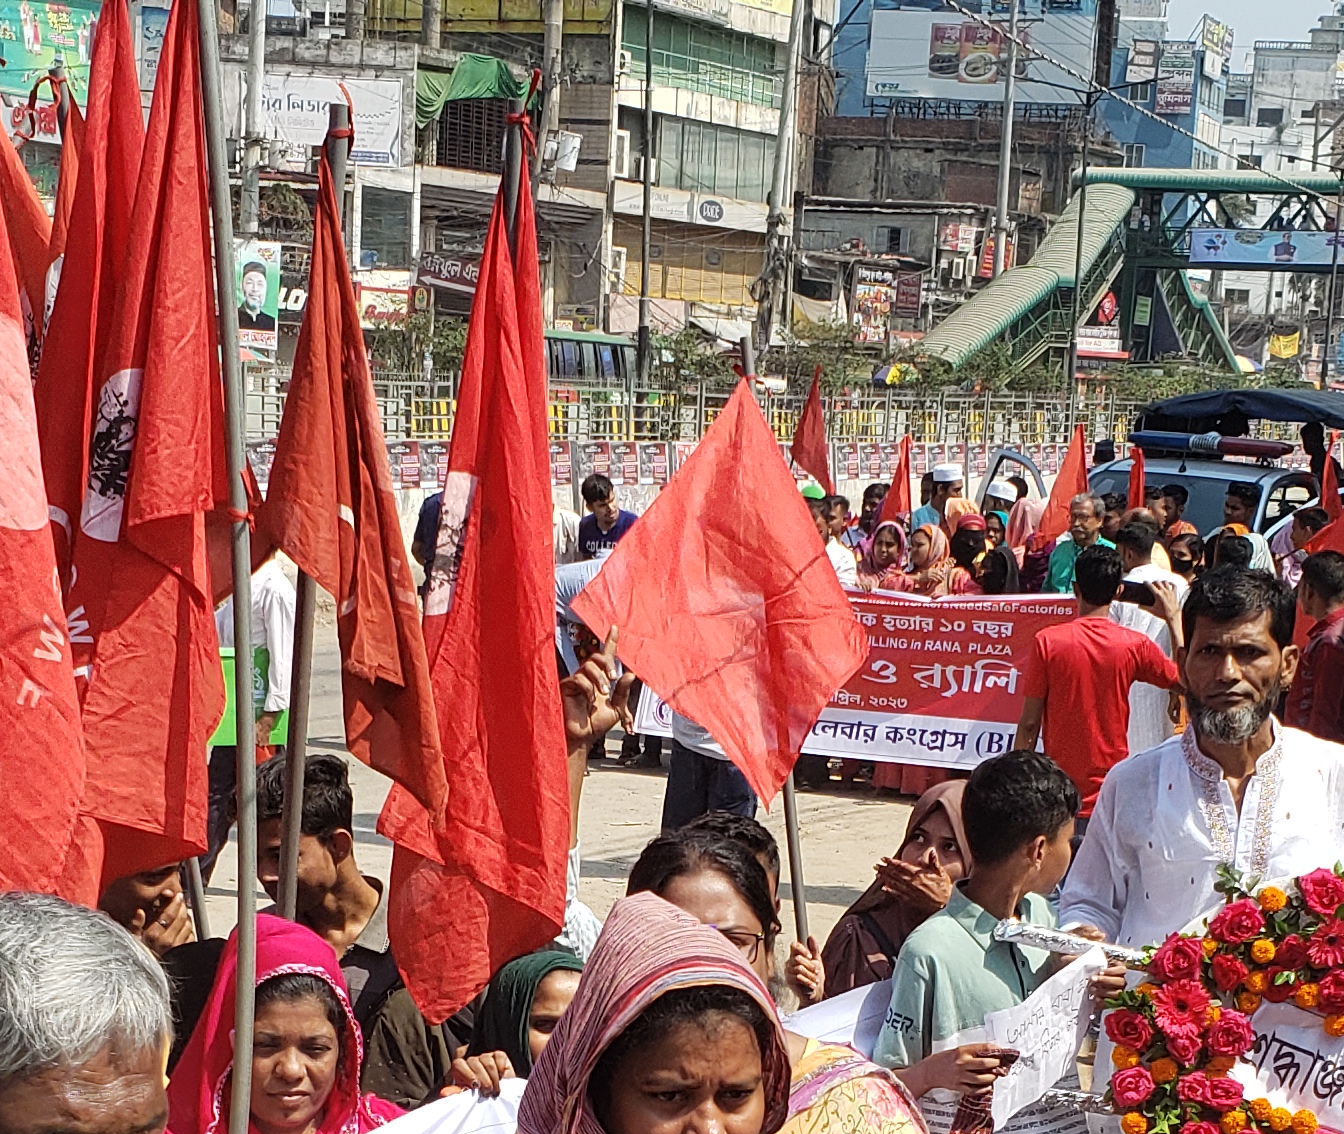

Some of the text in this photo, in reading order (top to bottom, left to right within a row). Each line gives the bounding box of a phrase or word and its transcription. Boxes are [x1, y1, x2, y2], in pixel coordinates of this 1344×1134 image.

[882, 615, 934, 632] হত্যার
[939, 619, 966, 632] ১০
[972, 619, 1014, 638] বছর
[868, 636, 908, 649] ILLING
[924, 640, 962, 653] RANA
[968, 643, 1012, 656] PLAZA
[861, 659, 898, 684] ও
[830, 690, 908, 709] প্রিল, ২০২৩
[812, 718, 879, 745] লেবার
[885, 725, 969, 752] কংগ্রেস
